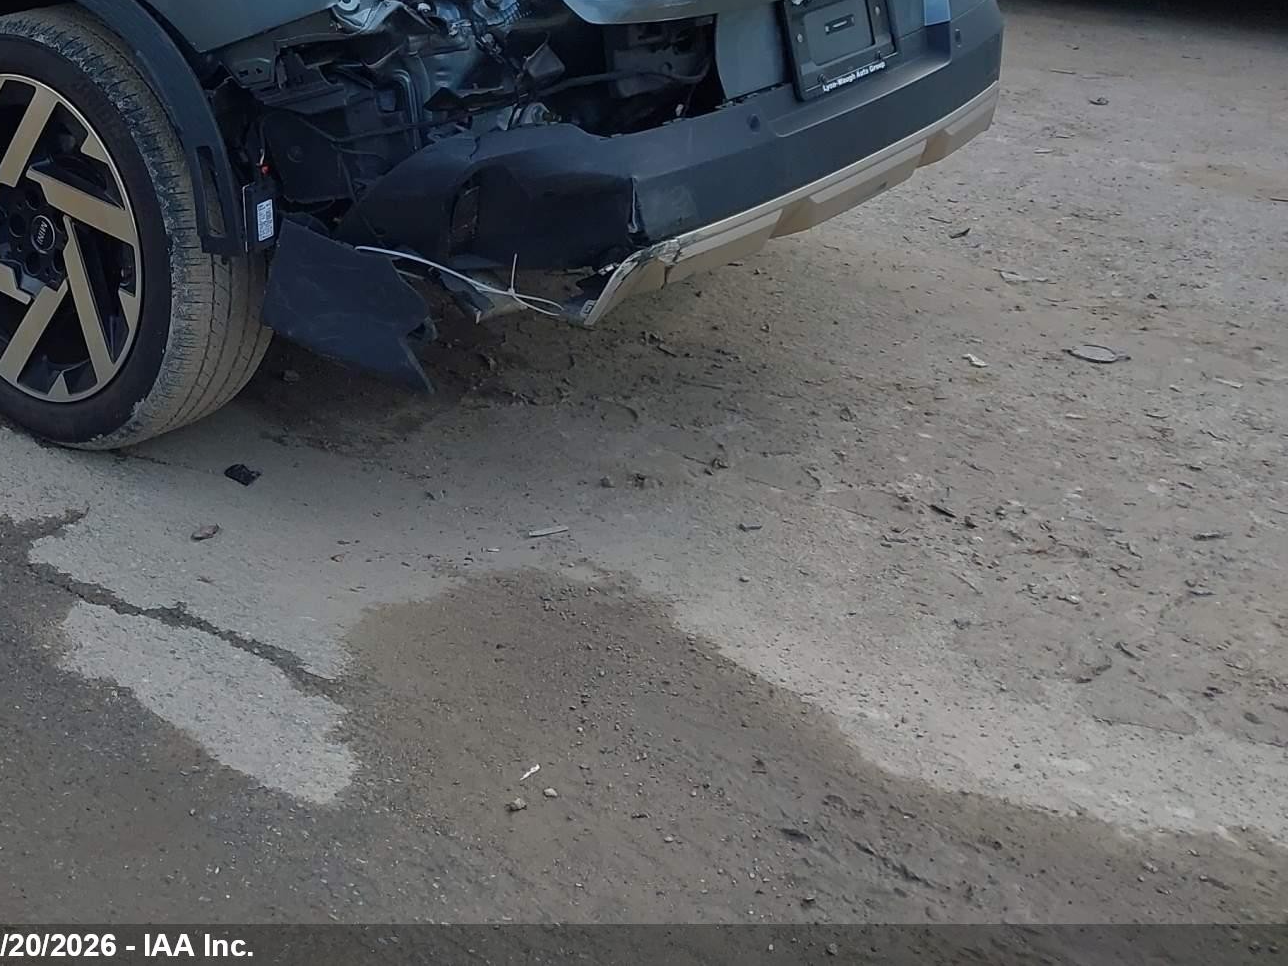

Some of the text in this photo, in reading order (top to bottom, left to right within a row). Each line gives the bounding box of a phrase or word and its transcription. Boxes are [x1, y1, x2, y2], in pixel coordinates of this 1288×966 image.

[856, 67, 869, 78] Auto
[869, 61, 886, 73] Group
[36, 220, 48, 246] MINI
